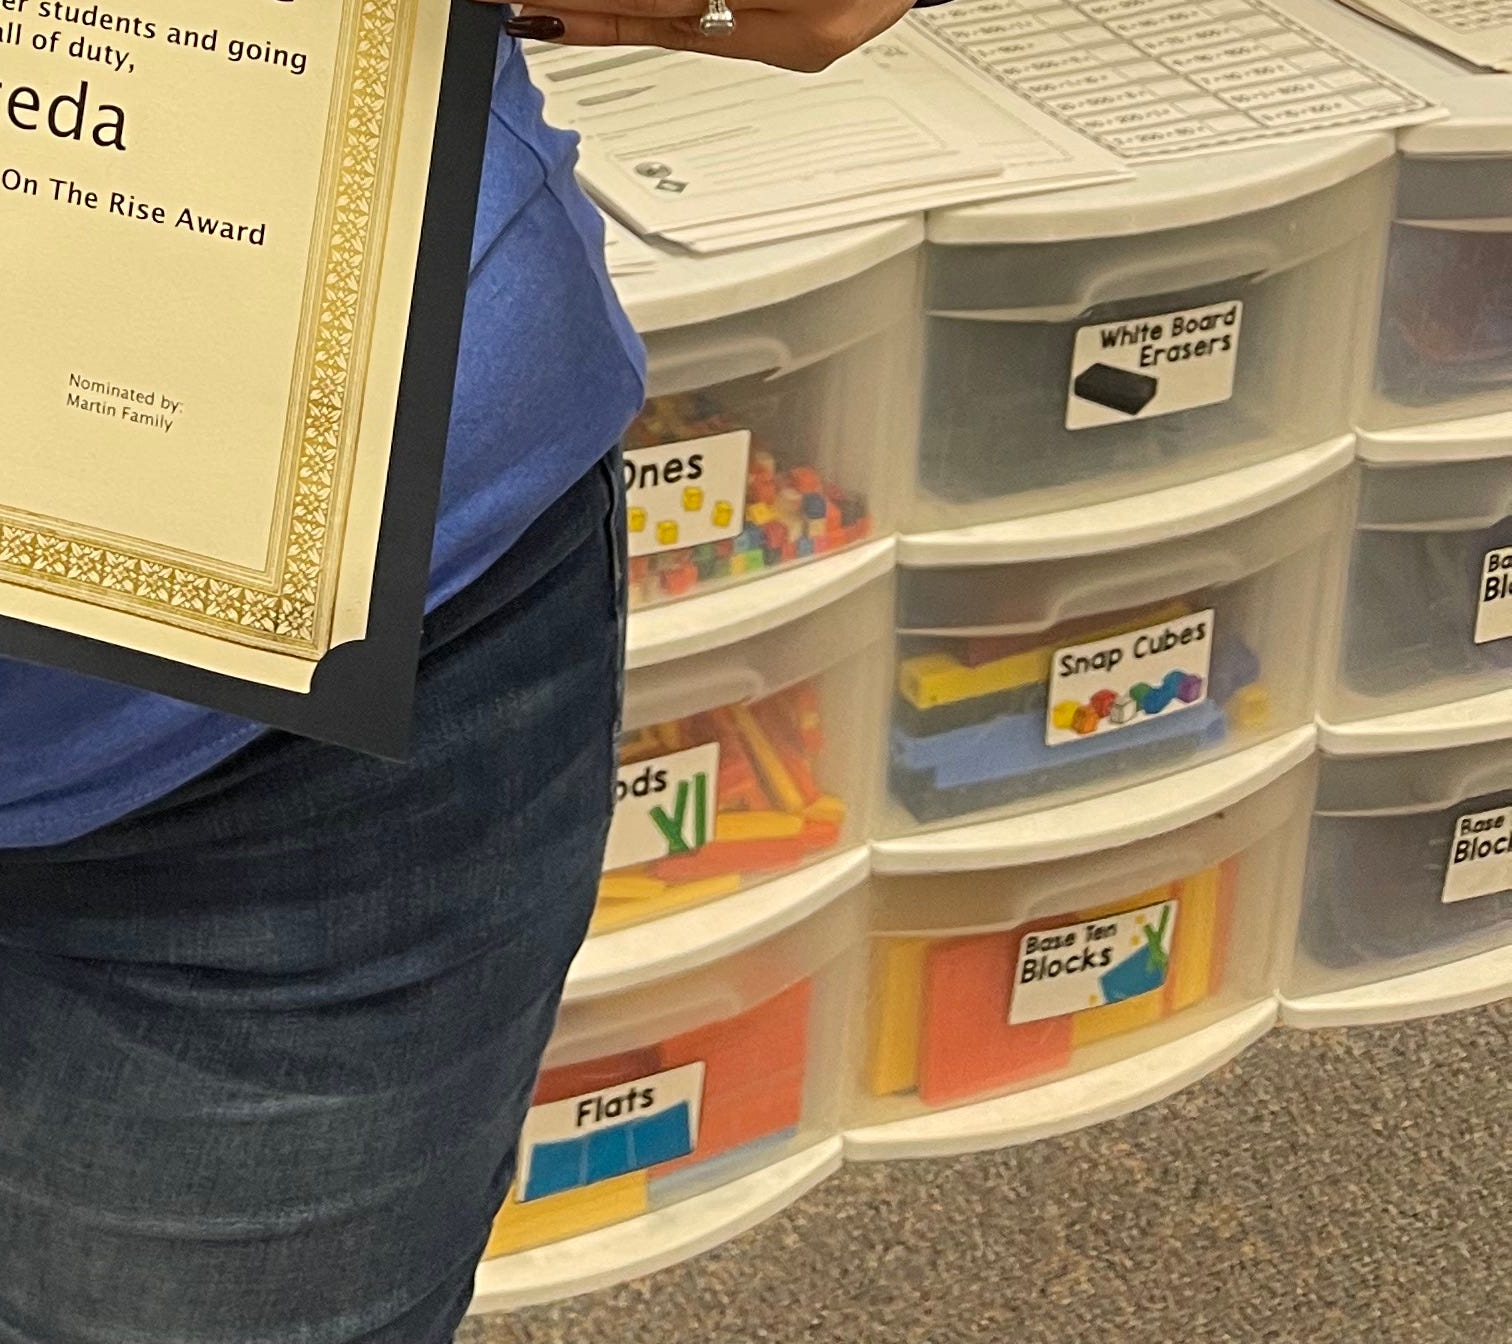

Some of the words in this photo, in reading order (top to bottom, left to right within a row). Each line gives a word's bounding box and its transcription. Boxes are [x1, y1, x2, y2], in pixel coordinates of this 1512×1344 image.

[31, 30, 62, 54] of
[68, 35, 136, 74] duty,
[166, 25, 219, 52] and
[227, 39, 308, 76] going
[1, 168, 39, 196] On
[48, 177, 99, 210] The
[109, 192, 167, 224] Rise
[174, 207, 267, 247] Award
[1099, 318, 1164, 351] White
[1170, 305, 1237, 338] Board
[1138, 332, 1233, 369] Erasers
[68, 372, 155, 407] Nominated
[65, 392, 117, 418] Martin
[121, 406, 174, 434] Family
[1058, 646, 1124, 678] Snap
[1133, 620, 1208, 660] Cubes
[1460, 815, 1506, 837] Base
[1024, 929, 1076, 956] Base
[1084, 920, 1119, 945] Ten
[1019, 943, 1113, 985] Blocks
[574, 1082, 656, 1129] Flats
